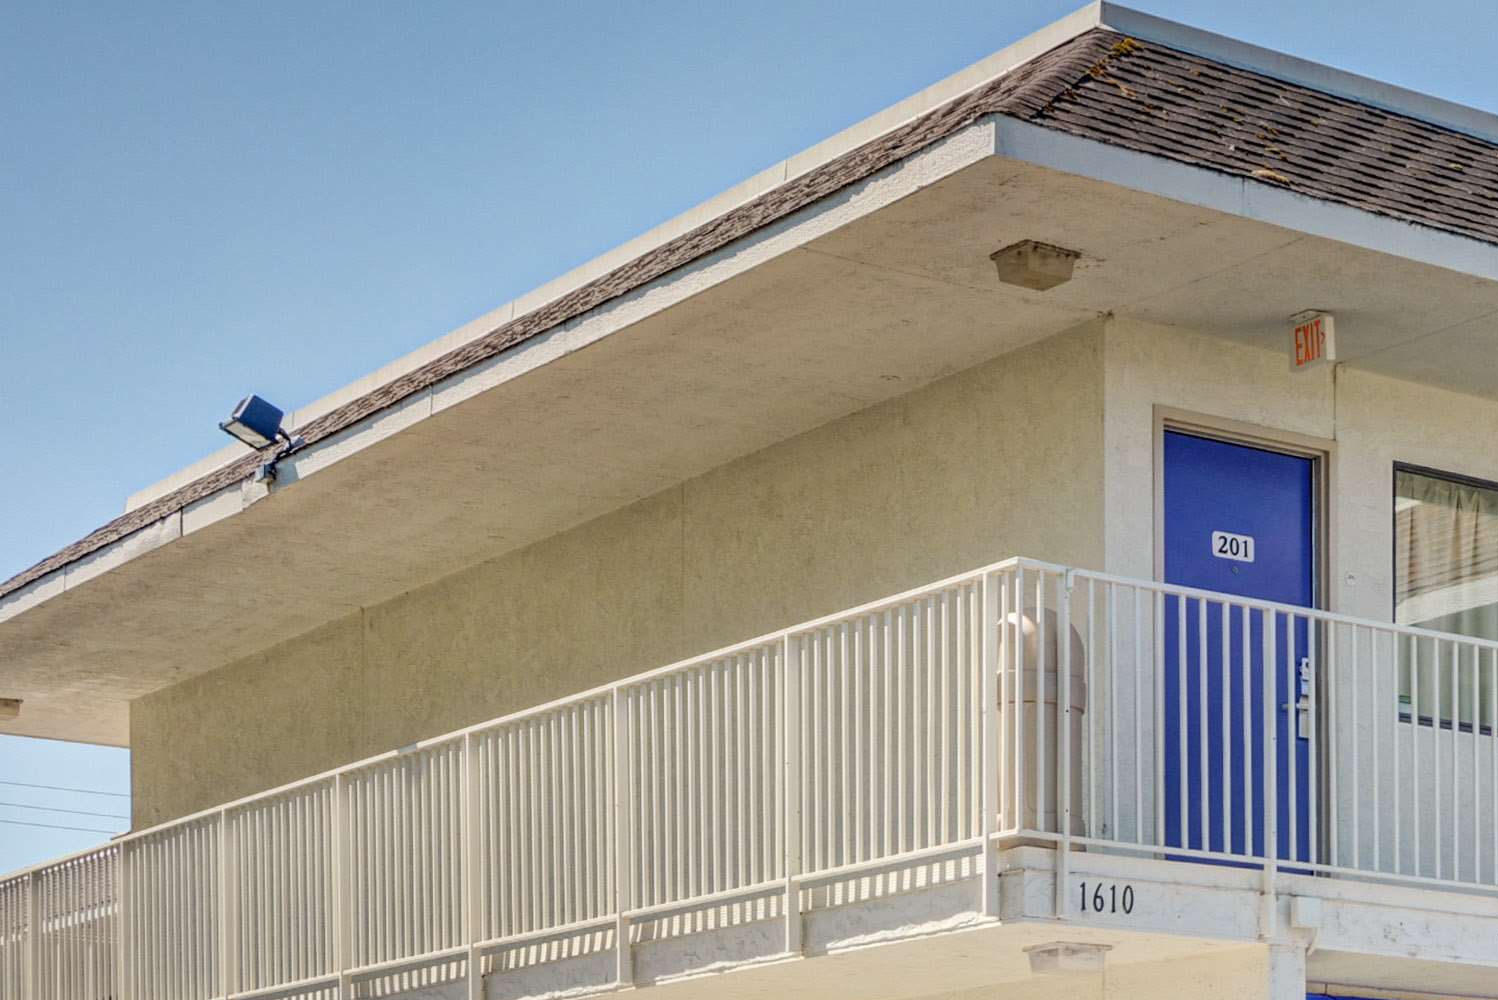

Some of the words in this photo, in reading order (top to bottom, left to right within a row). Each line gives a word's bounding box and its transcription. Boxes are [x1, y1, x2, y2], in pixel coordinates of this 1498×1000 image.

[1294, 319, 1321, 366] EXIT
[1217, 535, 1248, 558] 201
[1080, 881, 1134, 914] 1610
